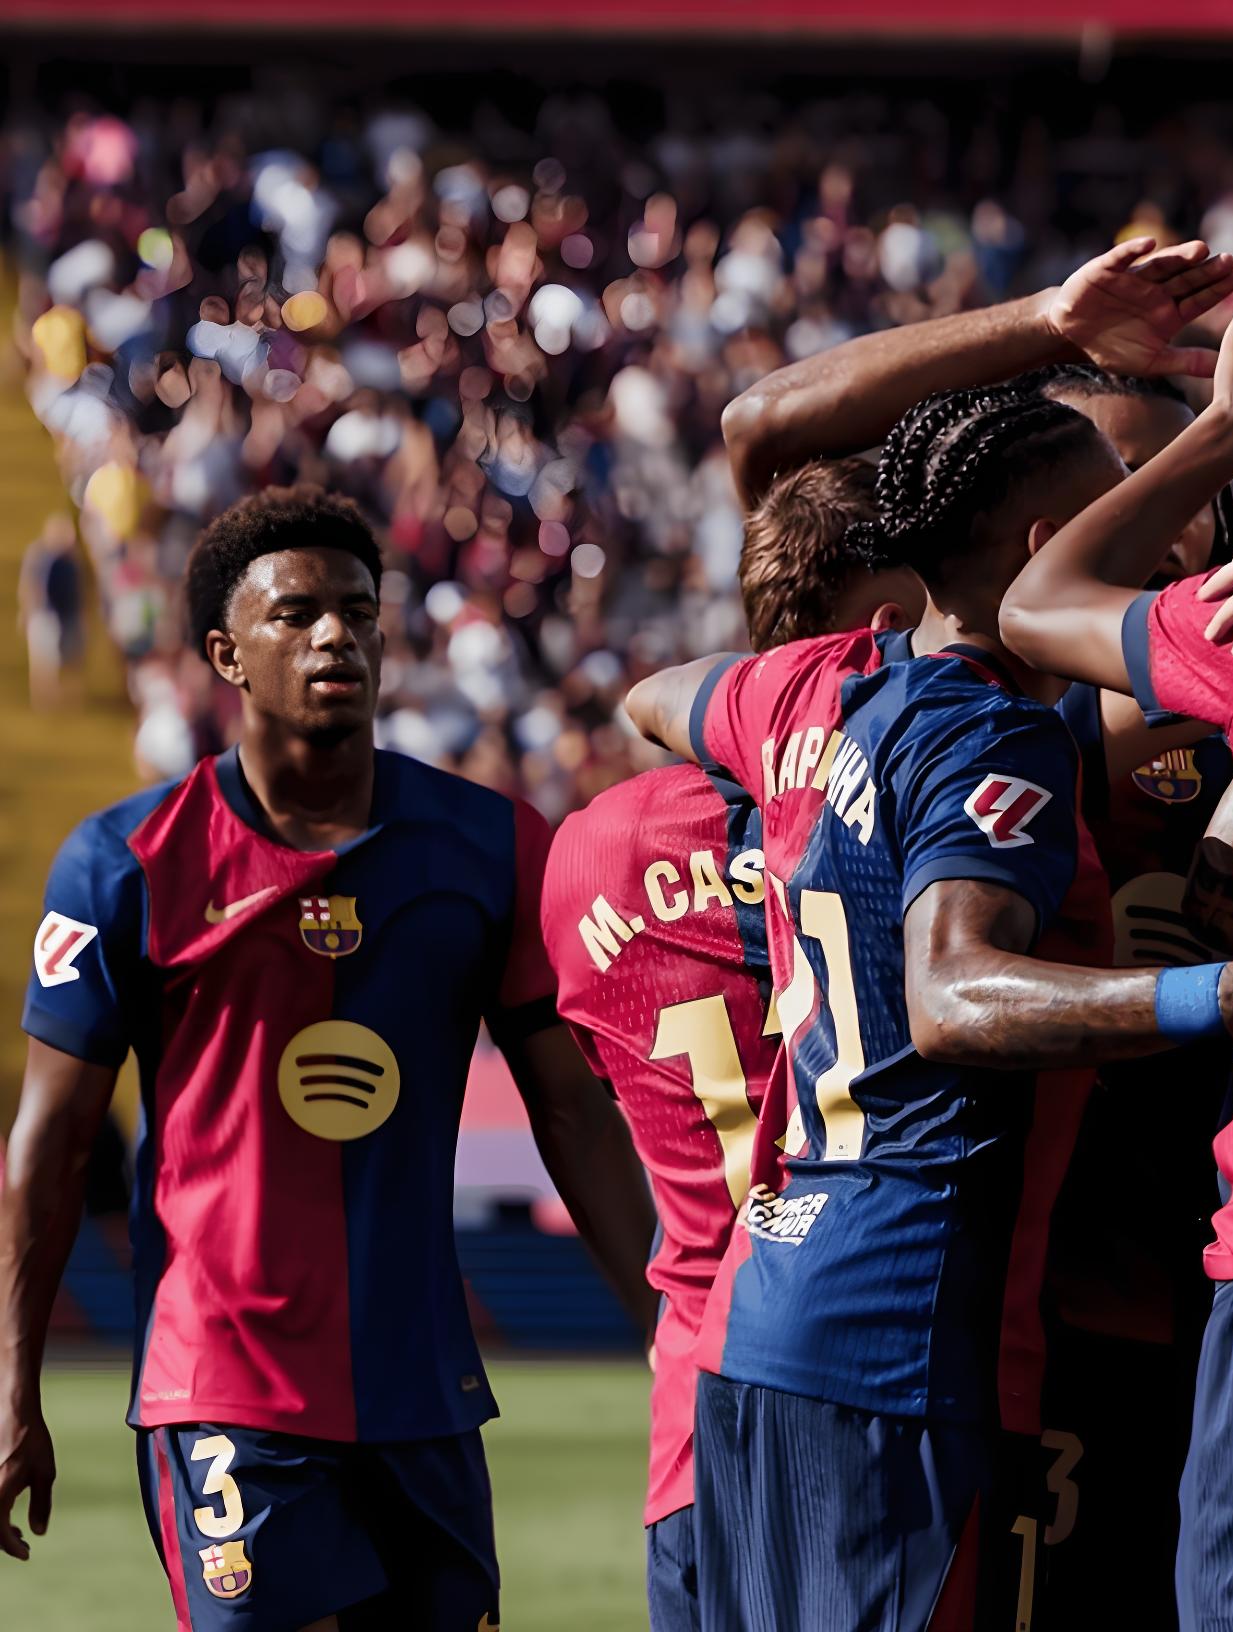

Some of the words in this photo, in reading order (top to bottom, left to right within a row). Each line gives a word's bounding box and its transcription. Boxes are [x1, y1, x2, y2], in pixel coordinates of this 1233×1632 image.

[578, 894, 646, 973] M.
[190, 1434, 244, 1538] 3
[1041, 1429, 1084, 1546] 3
